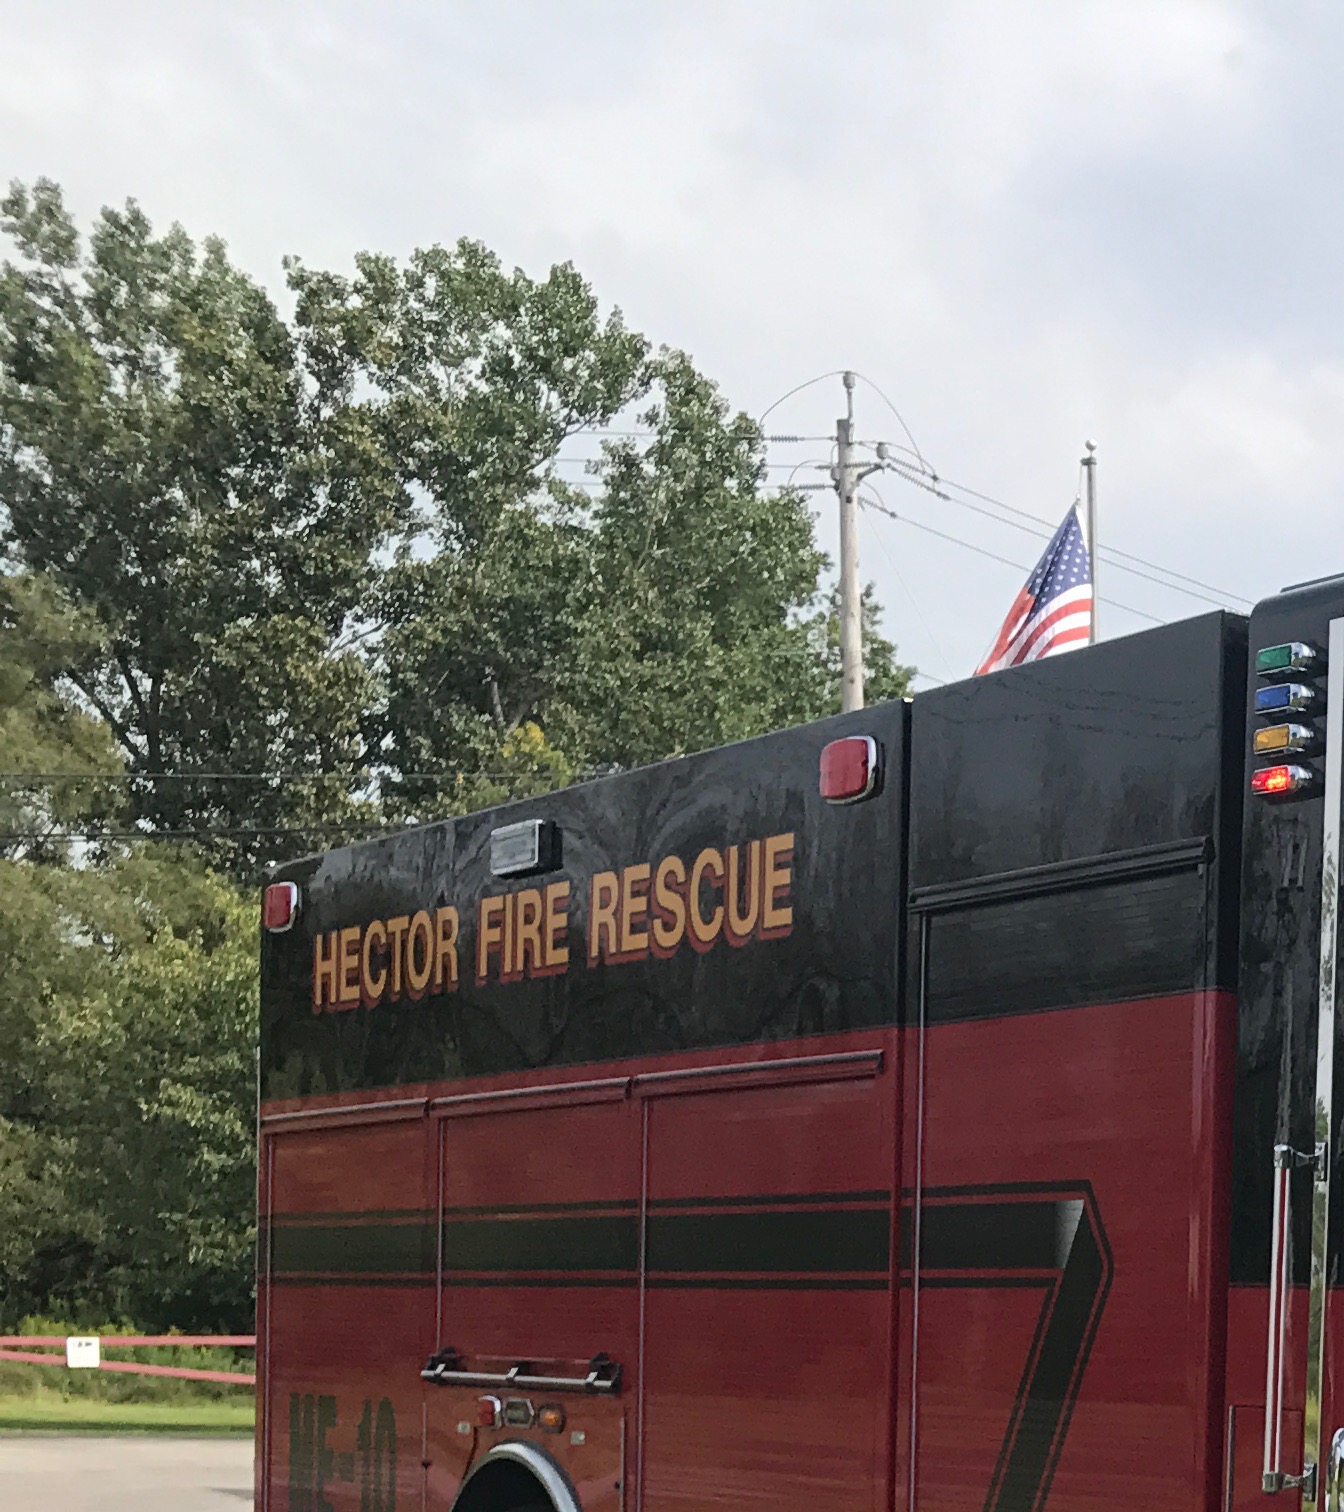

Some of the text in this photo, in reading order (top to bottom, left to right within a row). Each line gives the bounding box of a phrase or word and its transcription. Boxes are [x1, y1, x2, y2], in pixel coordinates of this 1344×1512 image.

[312, 832, 794, 1013] HECTOR FIRE RESCUE
